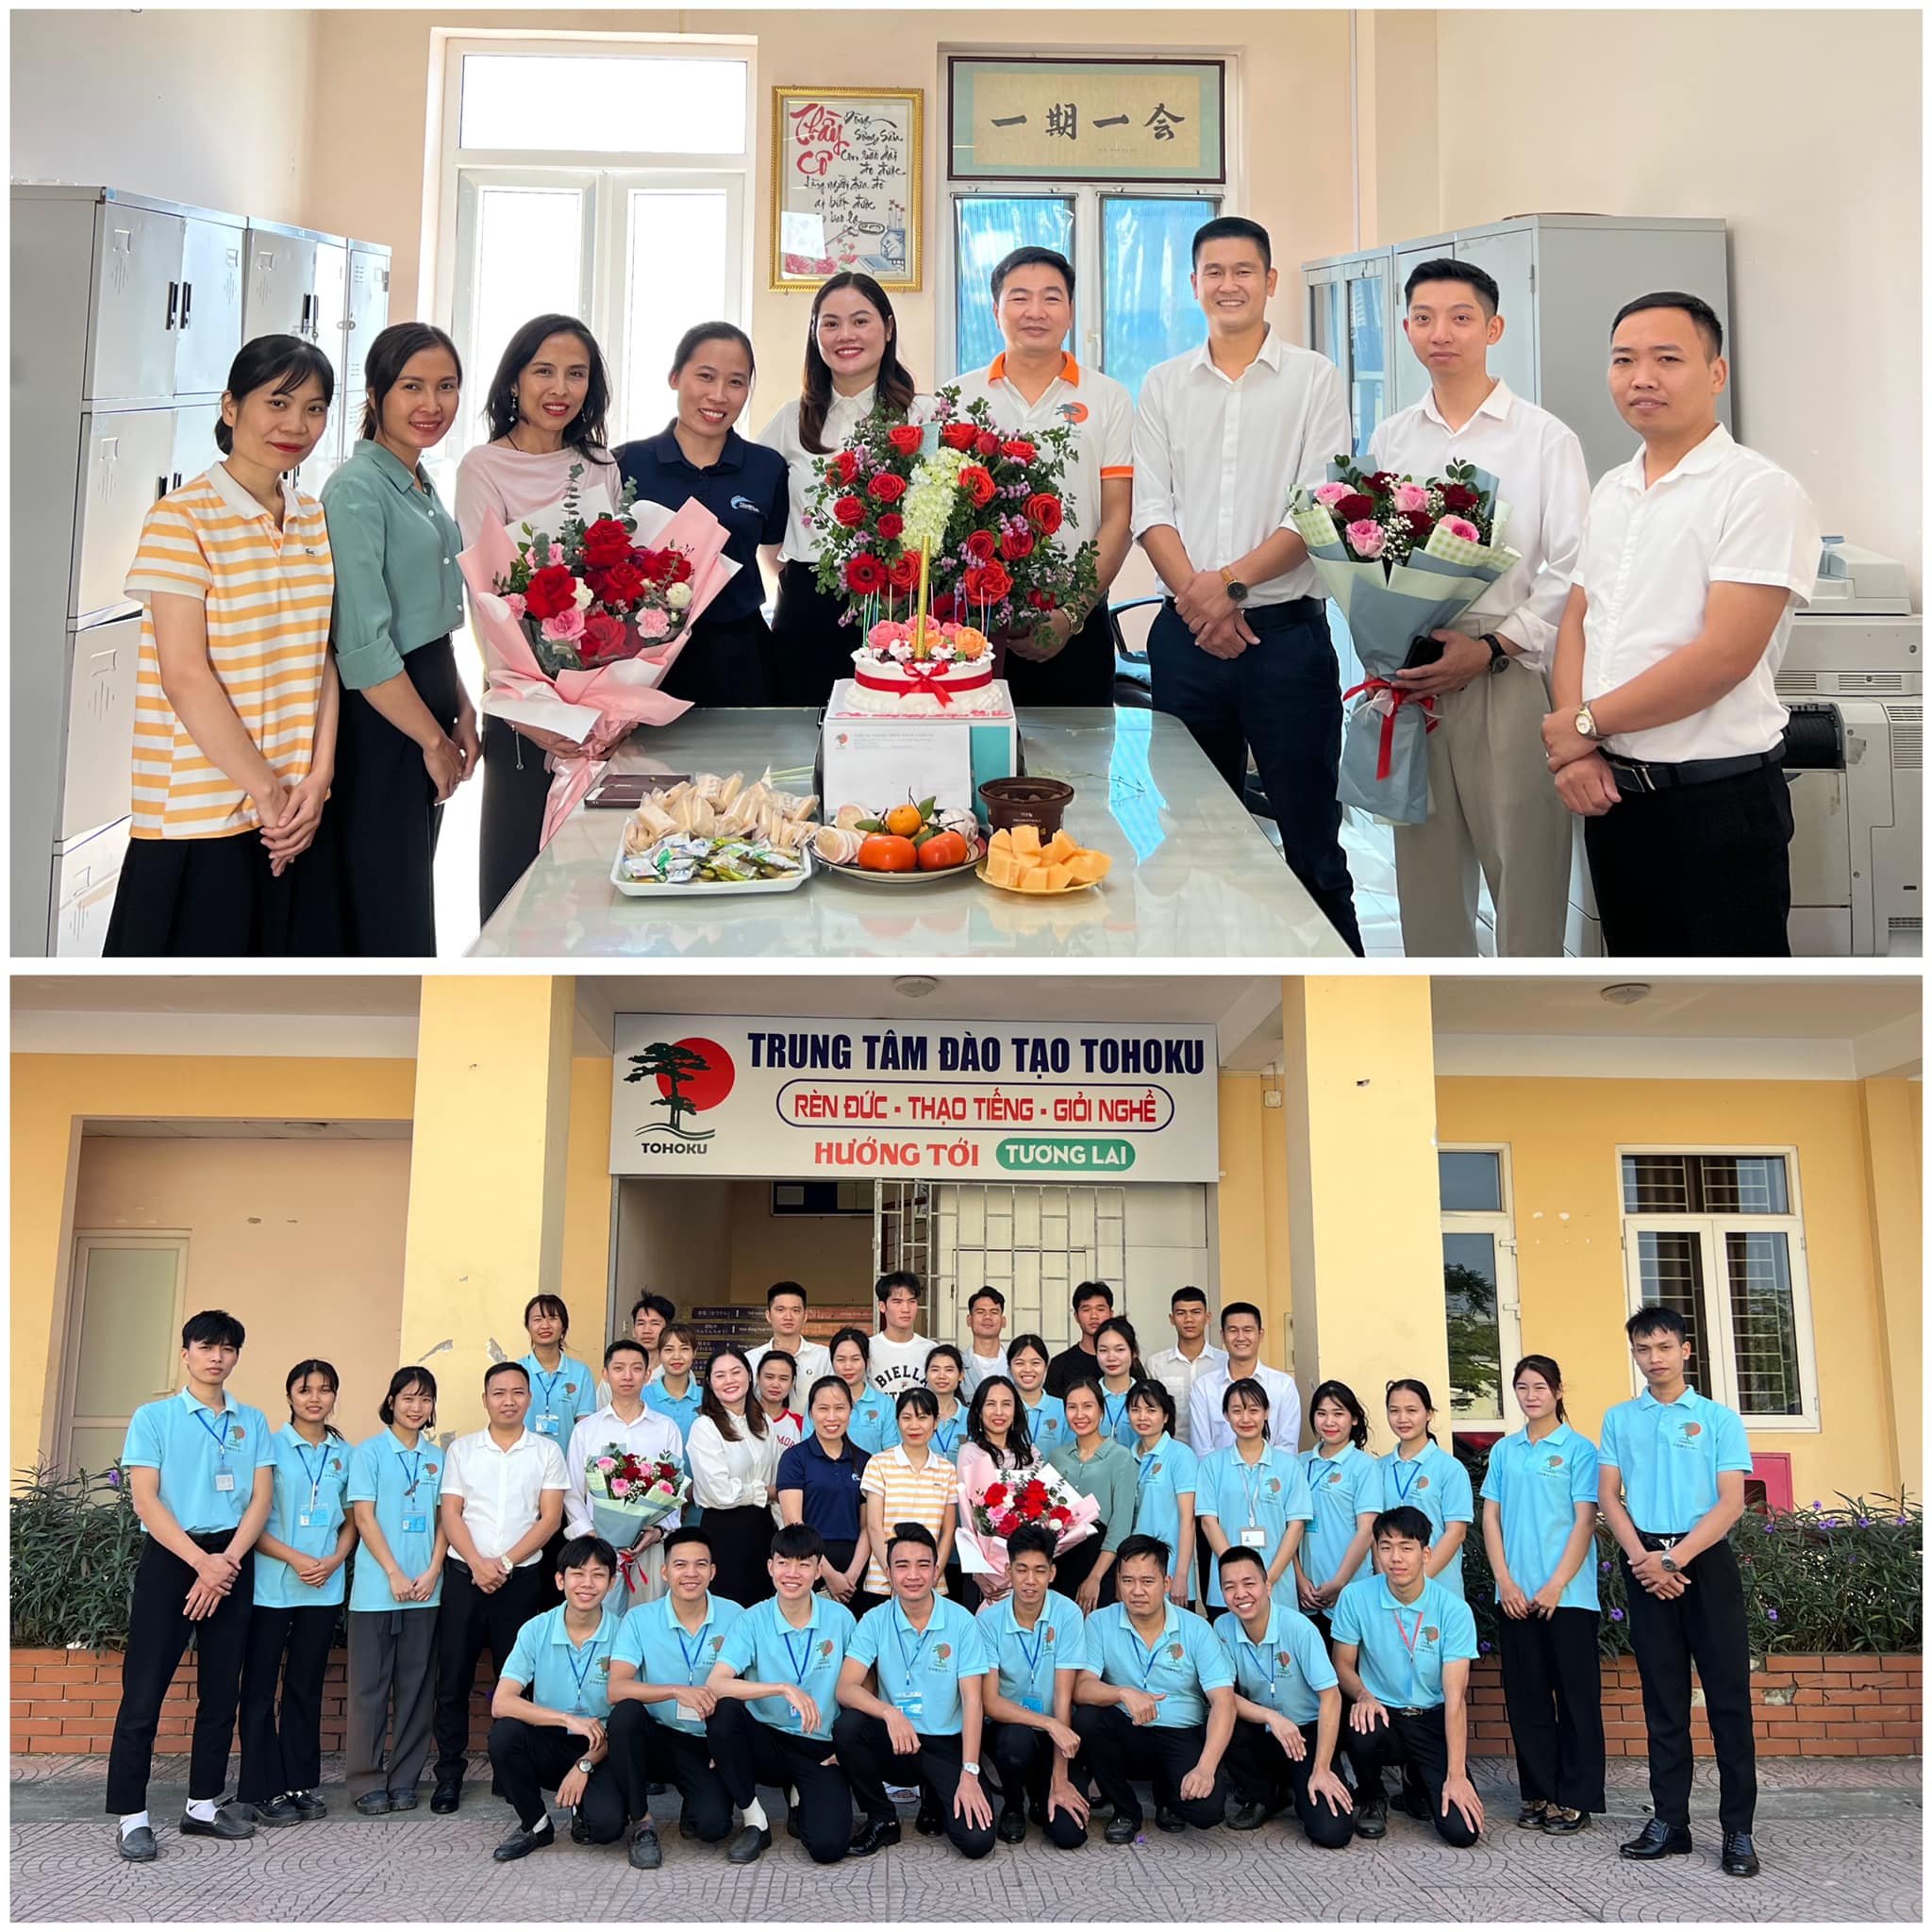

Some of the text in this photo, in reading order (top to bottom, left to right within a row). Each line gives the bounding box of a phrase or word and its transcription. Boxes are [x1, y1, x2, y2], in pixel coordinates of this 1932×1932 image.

[790, 104, 850, 155] Thầy
[991, 103, 1185, 141] 一期一会
[797, 150, 833, 175] Cô
[747, 1029, 1204, 1079] TRUNG TÂM ĐÀO TẠO TOHOKU
[794, 1090, 838, 1118] RÈN
[843, 1091, 888, 1119] ĐỨC
[908, 1096, 967, 1124] THẠO
[974, 1088, 1034, 1121] TIẾNG
[1054, 1091, 1092, 1123] GIỎI
[1099, 1089, 1157, 1123] NGHỀ
[641, 1142, 708, 1155] TOHOKU
[814, 1136, 1126, 1166] HƯỚNG TỚI TƯƠNG LAI
